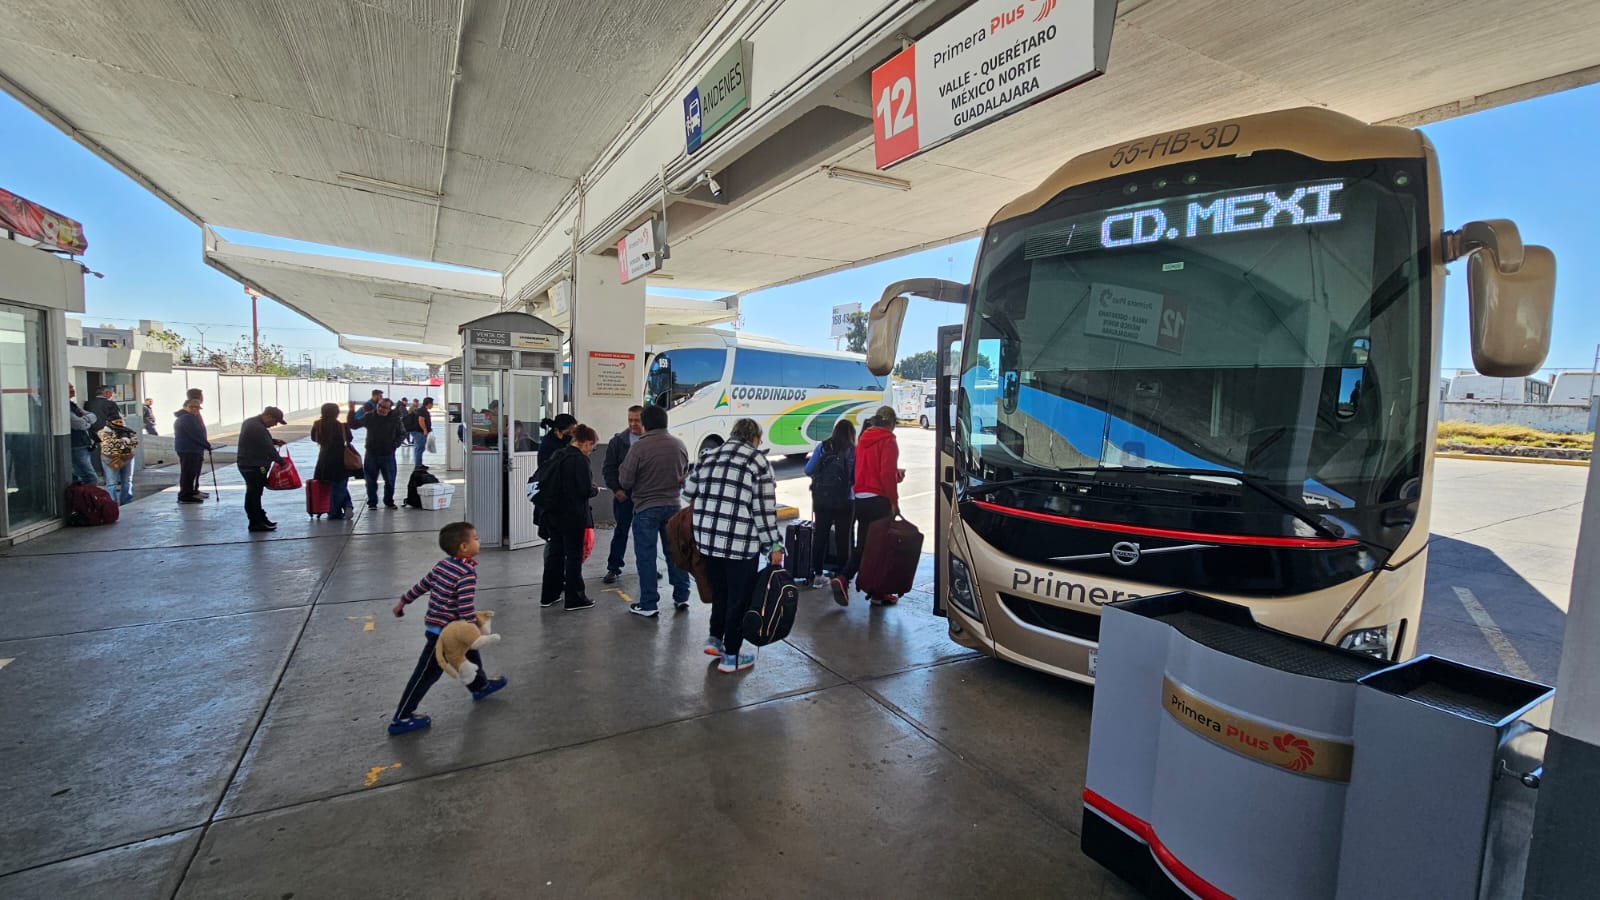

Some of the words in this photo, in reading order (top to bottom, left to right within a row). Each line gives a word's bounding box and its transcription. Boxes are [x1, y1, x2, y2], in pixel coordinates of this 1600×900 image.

[933, 28, 987, 69] Primera
[990, 4, 1025, 36] Plus
[938, 71, 971, 98] VALLE
[981, 24, 1057, 76] QUERÉTARO
[703, 62, 742, 114] ANDENES
[876, 76, 914, 140] 12
[951, 78, 995, 111] MÉXICO
[998, 54, 1041, 87] NORTE
[953, 76, 1040, 127] GUADALAJARA
[1109, 123, 1241, 169] 55-HB-3D
[476, 337, 506, 345] BOLETOS
[731, 386, 807, 401] COORDINADOS
[1171, 694, 1221, 733] Primera
[1226, 724, 1270, 751] Plus
